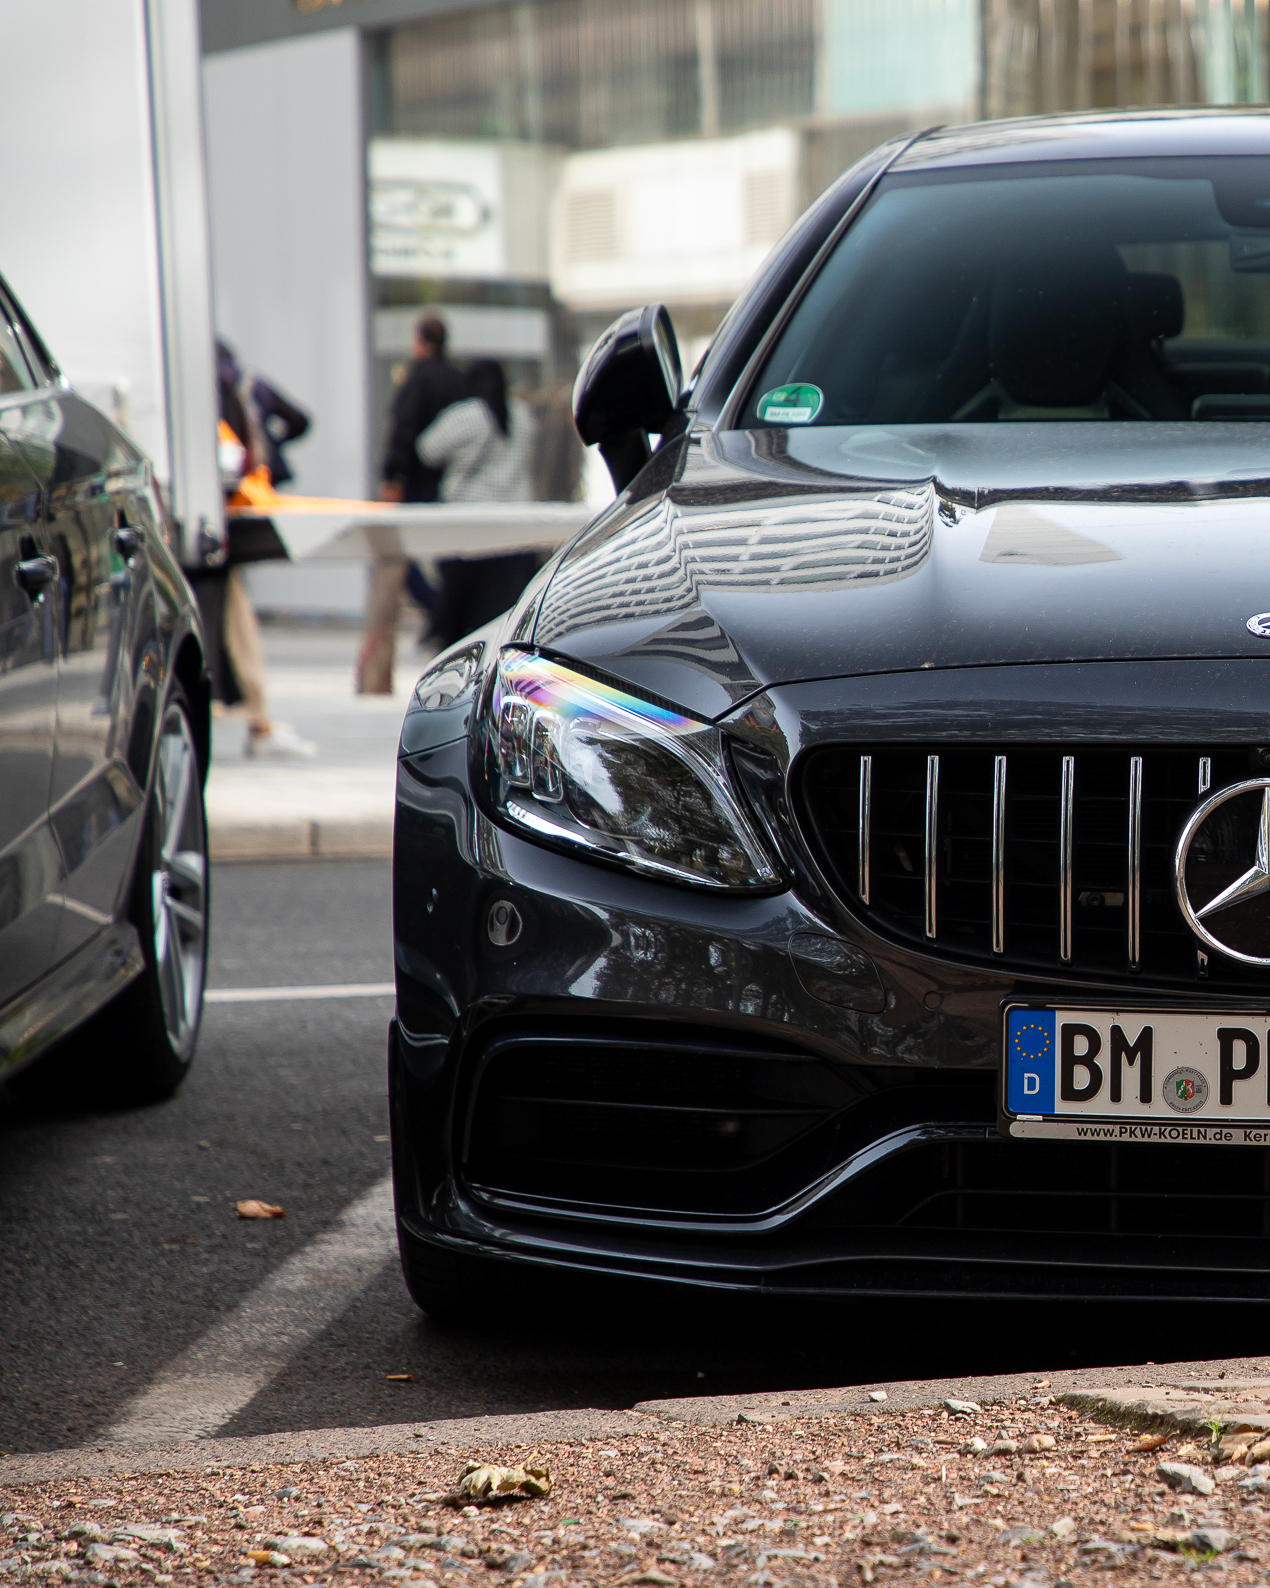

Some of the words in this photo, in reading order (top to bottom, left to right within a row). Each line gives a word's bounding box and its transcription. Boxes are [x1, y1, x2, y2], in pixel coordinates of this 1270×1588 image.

[1060, 1022, 1155, 1104] BM
[1022, 1072, 1041, 1095] D
[1076, 1125, 1234, 1142] www.PKW-KOELN.de
